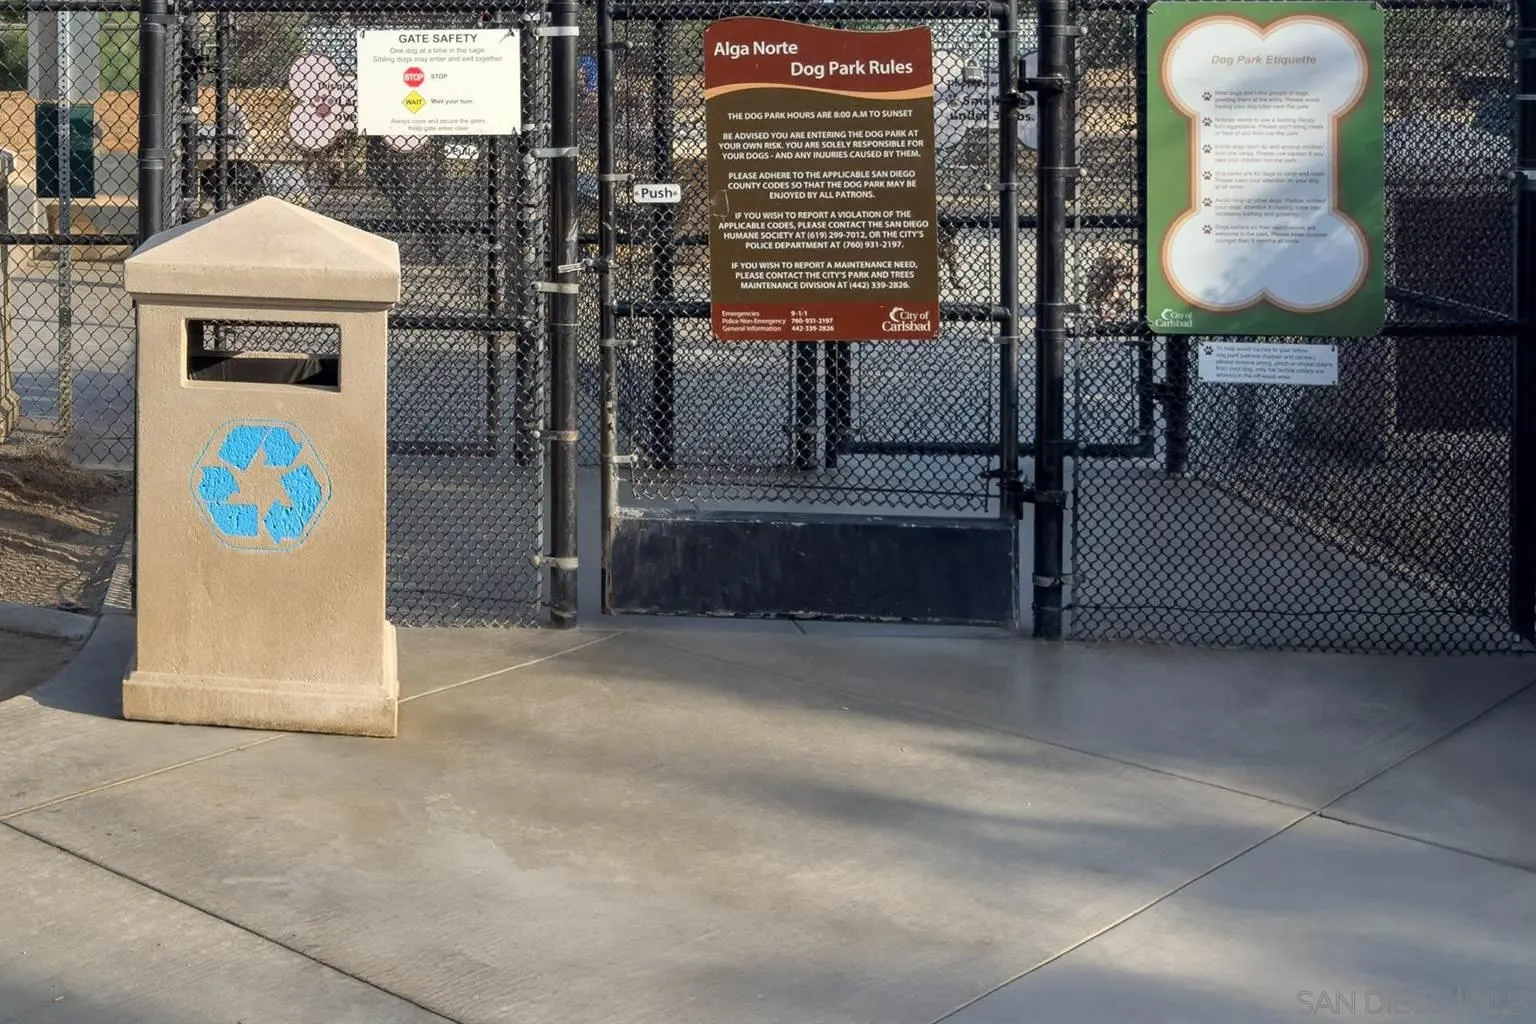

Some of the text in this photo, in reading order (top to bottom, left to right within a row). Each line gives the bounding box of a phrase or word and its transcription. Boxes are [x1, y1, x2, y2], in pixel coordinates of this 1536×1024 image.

[398, 34, 478, 43] GATE SAFETY
[405, 47, 418, 56] dog
[714, 40, 798, 59] Alga Norte
[1211, 55, 1317, 66] Dog Park Etiquette
[791, 59, 913, 79] Dog Park Rules
[404, 73, 424, 81] STOP
[727, 112, 743, 120] THE
[744, 112, 763, 120] DOG
[786, 111, 815, 119] HOURS
[833, 110, 851, 118] 8:00
[868, 110, 880, 118] TO
[881, 109, 912, 117] SUNSET
[722, 132, 733, 140] BE
[734, 132, 770, 140] ADVISED
[770, 131, 788, 139] YOU
[789, 131, 805, 139] ARE
[806, 130, 846, 139] ENTERING
[847, 130, 863, 138] THE
[864, 130, 884, 138] DOG
[907, 129, 918, 137] AT
[718, 142, 741, 150] YOUR
[742, 142, 763, 150] OWN
[785, 141, 803, 149] YOU
[804, 141, 820, 149] ARE
[821, 140, 851, 148] SOLELY
[852, 140, 906, 148] RESPONSIBLE
[907, 139, 924, 147] FOR
[722, 152, 745, 160] YOUR
[746, 151, 769, 160] DOGS
[775, 151, 793, 159] AND
[794, 151, 812, 159] ANY
[813, 150, 848, 159] INJURIES
[849, 150, 882, 158] CAUSED
[883, 150, 894, 158] BY
[728, 170, 916, 180] PLEASE ADHERE TO THE APPLICABLE SAN DIEGO
[727, 182, 761, 190] COUNTY
[762, 181, 790, 189] CODES
[791, 181, 802, 189] SO
[843, 180, 862, 188] DOG
[863, 180, 885, 188] PARK
[641, 187, 673, 199] Push
[769, 191, 806, 199] ENJOYED
[807, 191, 818, 199] BY
[819, 191, 834, 199] ALL
[743, 212, 761, 220] YOU
[762, 211, 784, 219] WISH
[784, 211, 796, 219] TO
[797, 211, 829, 219] REPORT
[837, 210, 881, 218] VIOLATION
[882, 210, 894, 218] OF
[895, 210, 911, 218] THE
[718, 222, 765, 230] APPLICABLE
[797, 221, 826, 229] PLEASE
[827, 221, 866, 229] CONTACT
[867, 220, 883, 228] THE
[884, 220, 902, 228] SAN
[902, 220, 929, 228] DIEGO
[723, 231, 759, 240] HUMANE
[760, 231, 794, 239] SOCIETY
[795, 231, 806, 239] AT
[807, 231, 827, 240] (619)
[868, 230, 881, 238] OR
[882, 230, 898, 238] THE
[774, 241, 828, 249] DEPARTMENT
[842, 241, 863, 249] (760)
[781, 261, 793, 269] TO
[794, 261, 825, 269] REPORT
[765, 271, 803, 279] CONTACT
[804, 271, 820, 279] THE
[870, 270, 889, 278] AND
[890, 270, 914, 278] TREES
[740, 281, 798, 289] MAINTENANCE
[800, 281, 836, 289] DIVISION
[849, 281, 870, 289] (442)
[721, 310, 760, 318] Emergencies
[900, 310, 929, 321] City of
[882, 320, 931, 332] Carlsbad
[1155, 319, 1193, 328] Carlsbad
